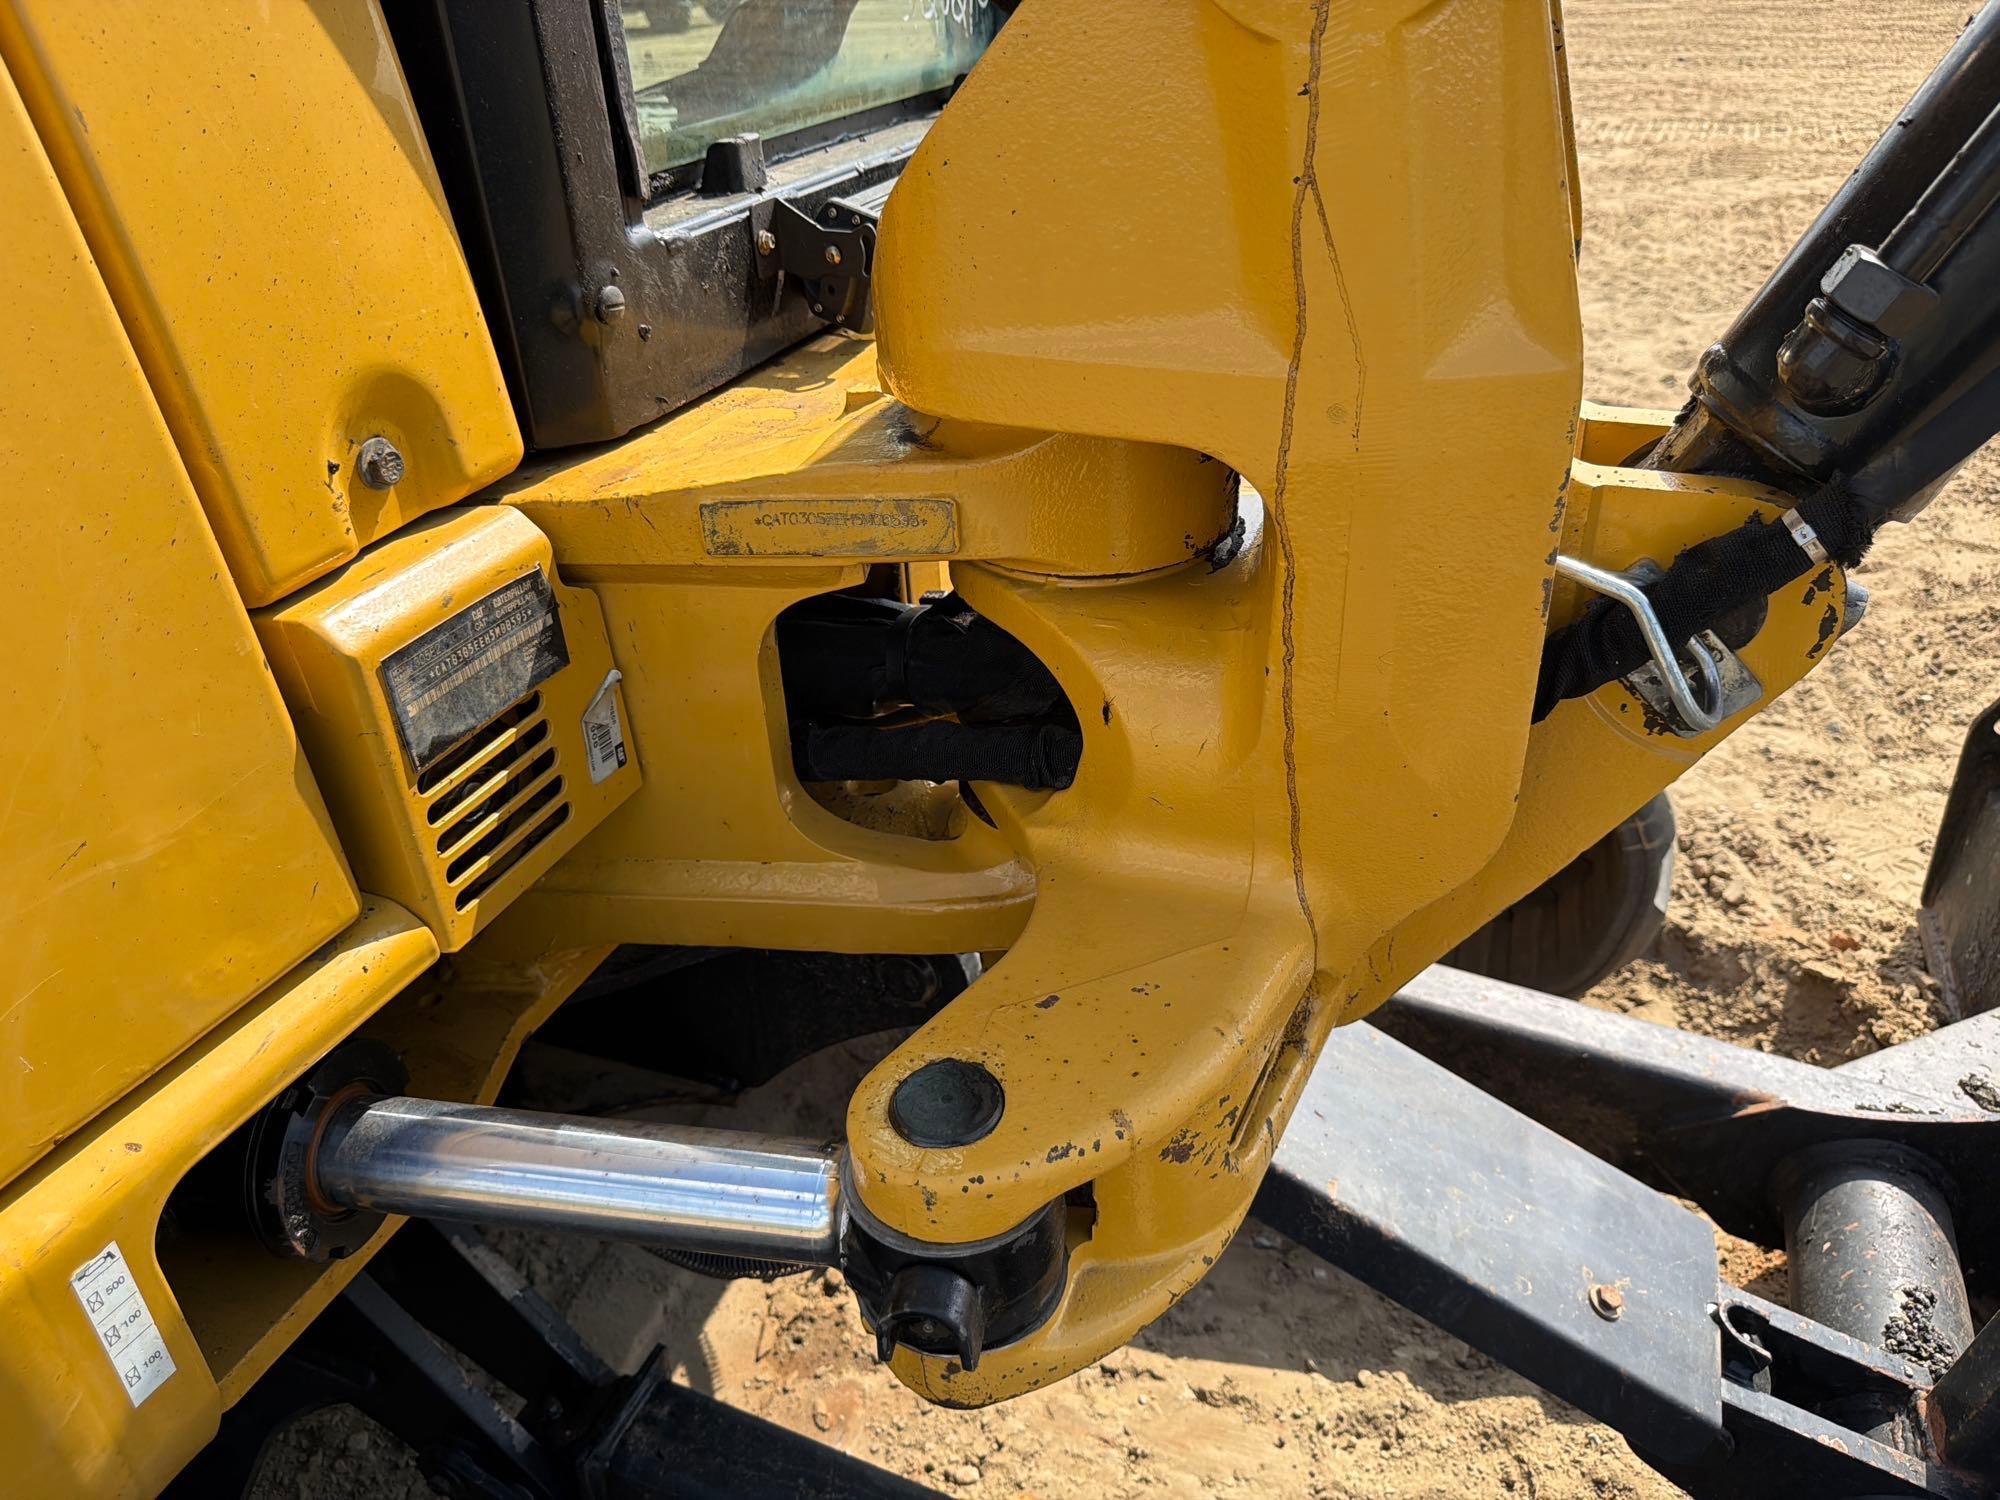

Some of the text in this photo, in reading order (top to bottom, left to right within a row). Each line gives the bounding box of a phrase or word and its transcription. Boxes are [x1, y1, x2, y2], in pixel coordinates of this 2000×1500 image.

[105, 1275, 126, 1296] 500
[122, 1309, 142, 1328] 100
[143, 1350, 162, 1369] 100
